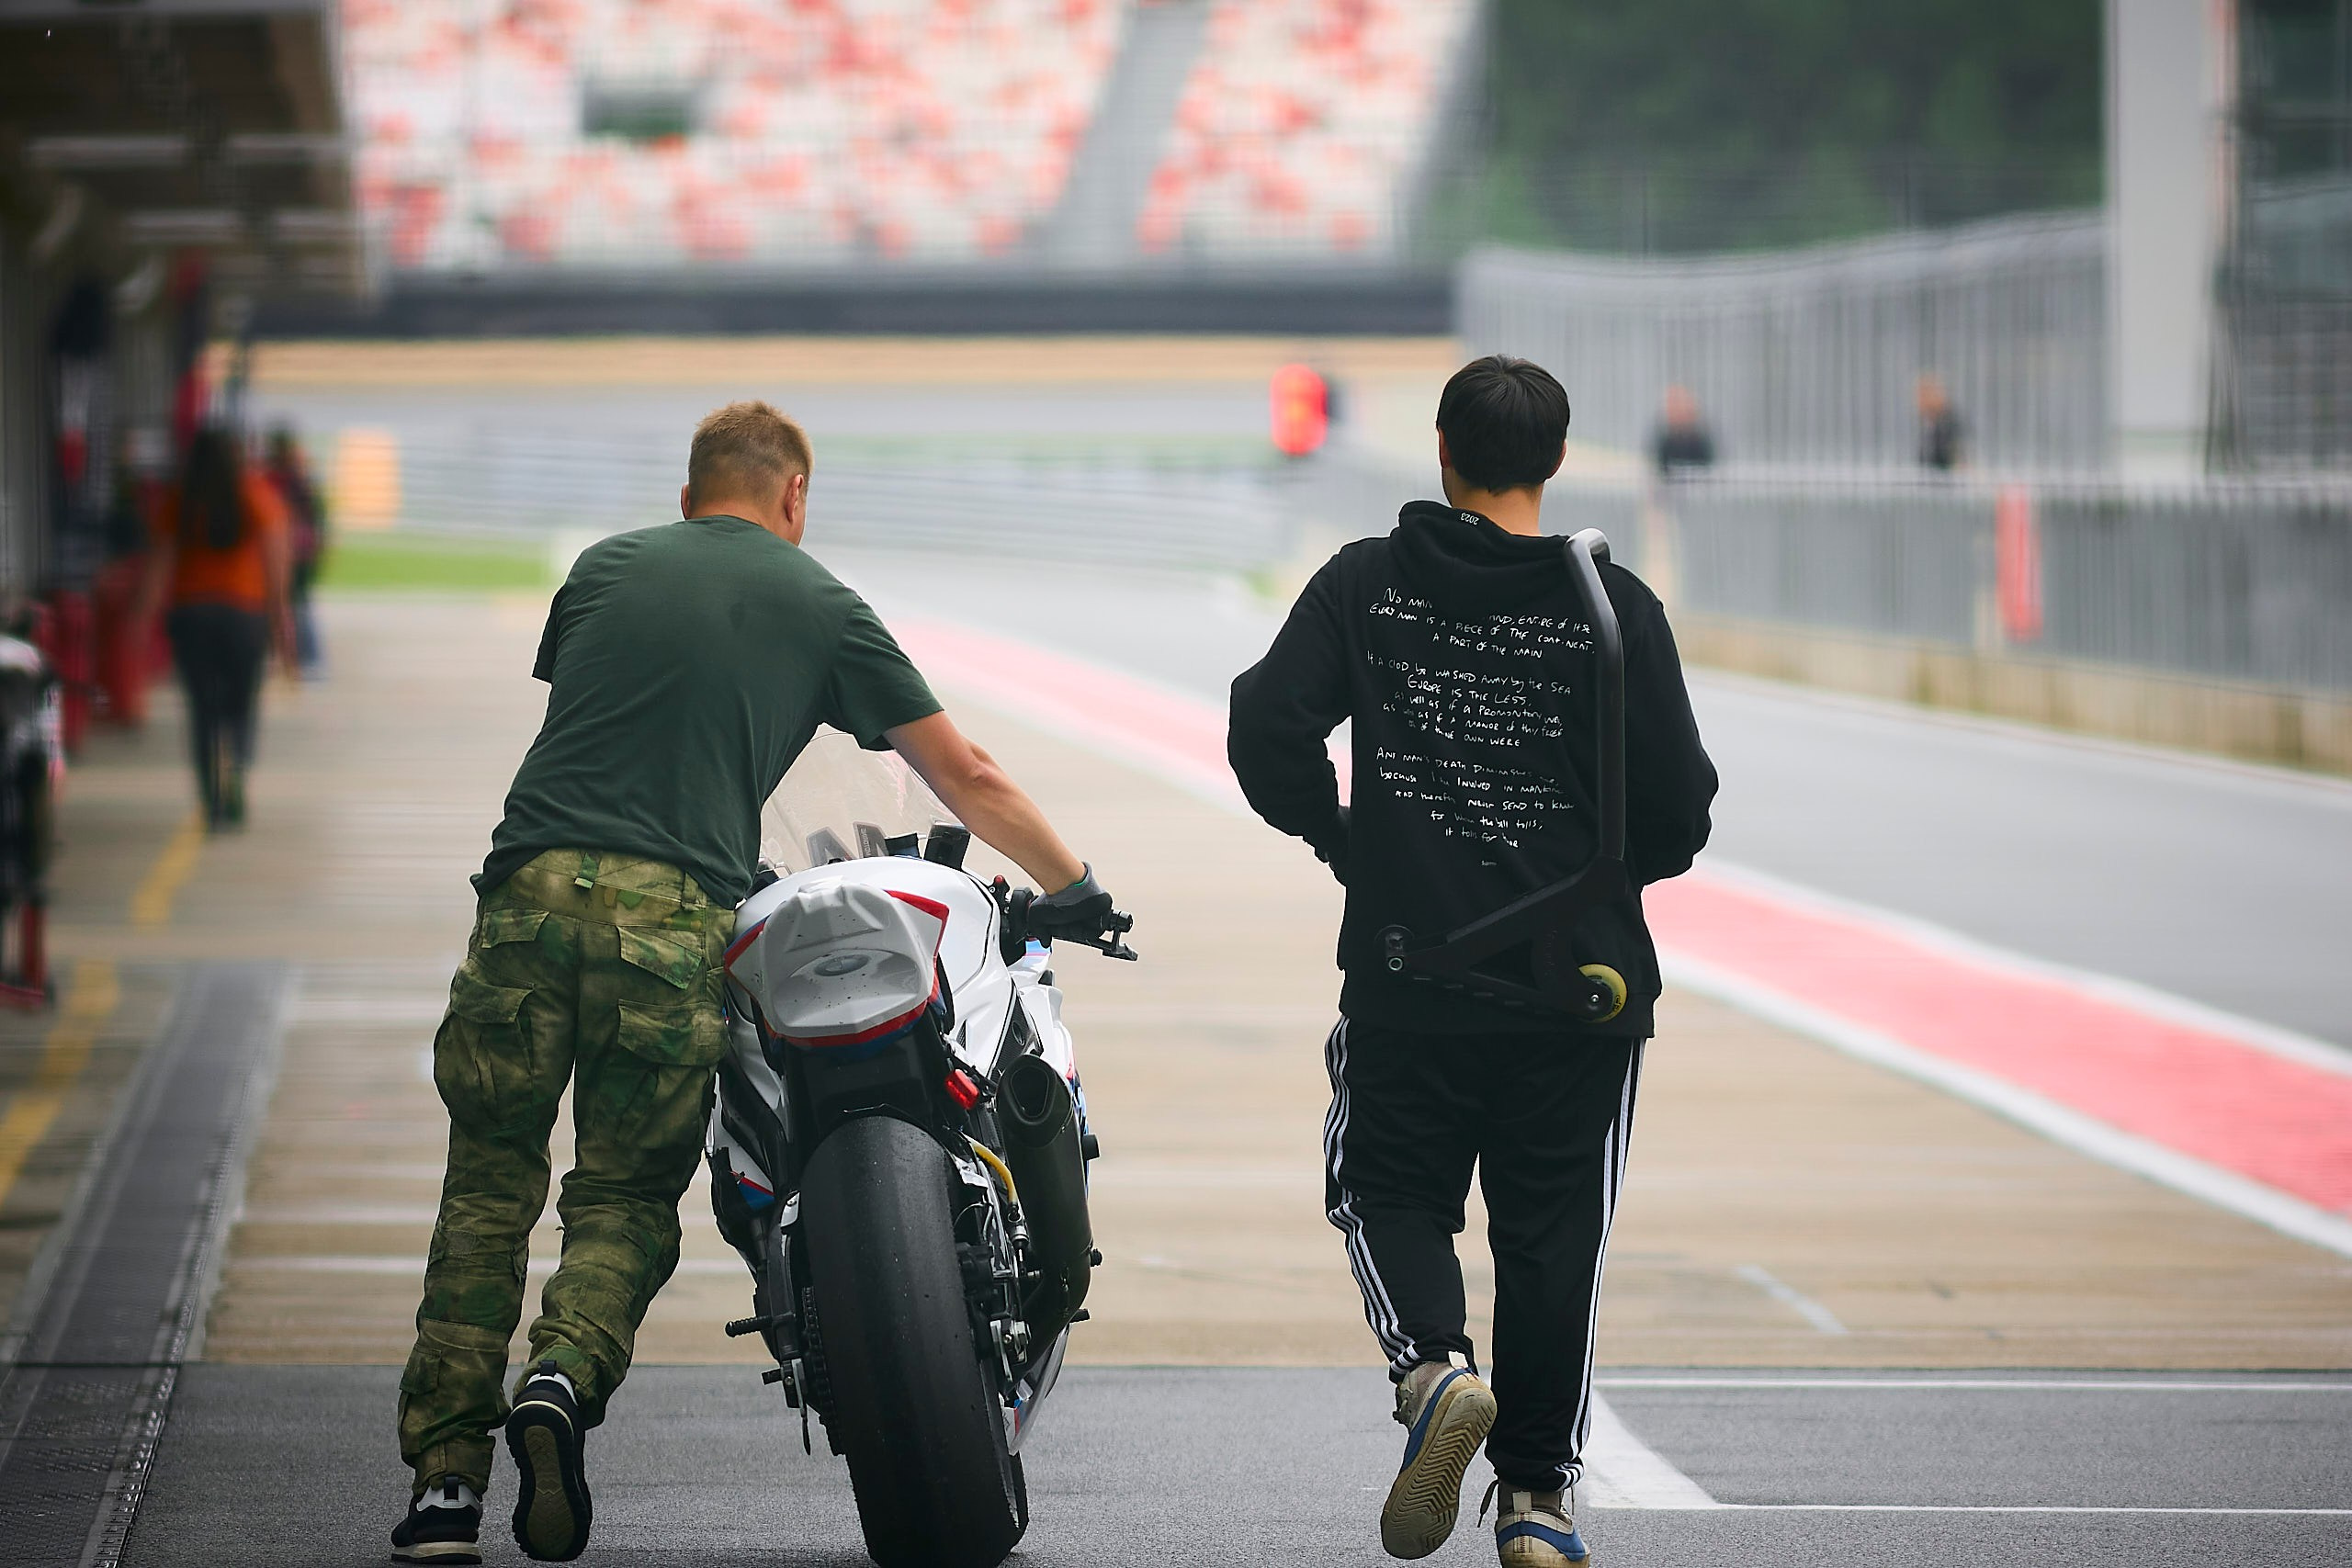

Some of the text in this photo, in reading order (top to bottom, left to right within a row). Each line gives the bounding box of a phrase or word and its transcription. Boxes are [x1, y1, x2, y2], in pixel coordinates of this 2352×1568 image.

[1461, 512, 1479, 525] 2023
[1408, 598, 1432, 609] MAN
[1396, 611, 1417, 621] MAN
[1426, 616, 1435, 625] IS
[1455, 622, 1483, 636] PIECE
[1510, 627, 1529, 640] THE
[1432, 632, 1440, 642] A
[1449, 635, 1471, 649] PART
[1491, 644, 1507, 656] THE
[1513, 648, 1543, 659] MAIN
[1435, 670, 1476, 682] WASHED
[1551, 682, 1571, 695] SEA
[1408, 673, 1532, 706] EUROPE IS THE LESS,
[1464, 719, 1499, 731] MANOR
[1489, 737, 1521, 747] WERE
[1502, 800, 1529, 811] SEND
